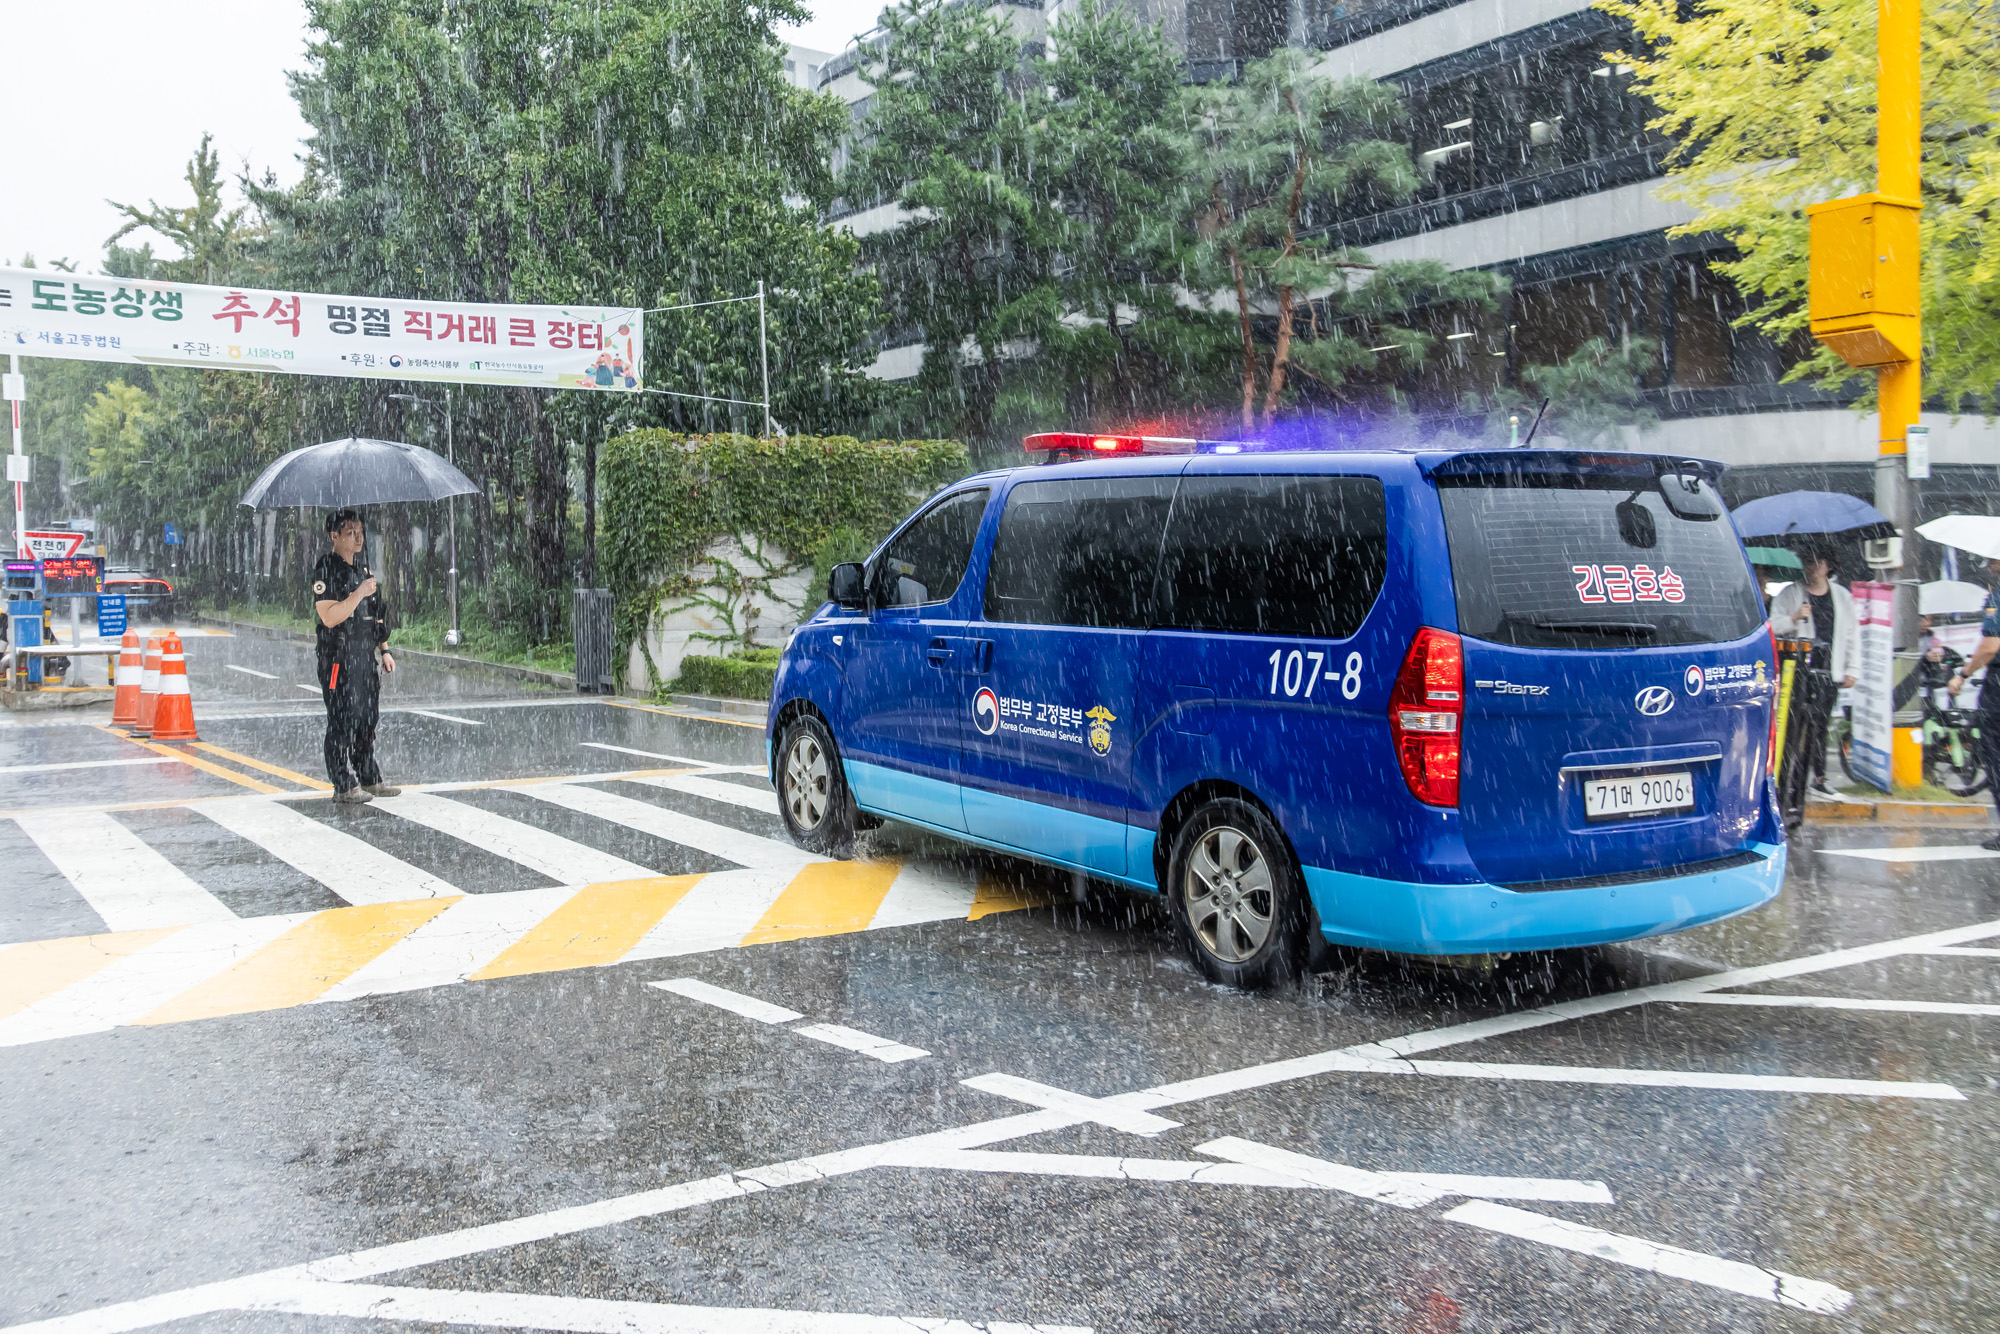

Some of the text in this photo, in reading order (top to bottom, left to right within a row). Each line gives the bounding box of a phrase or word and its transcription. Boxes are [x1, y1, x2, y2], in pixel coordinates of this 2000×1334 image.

[31, 279, 184, 322] 도농상생
[212, 291, 302, 338] 추석
[327, 304, 391, 338] 명절
[404, 310, 497, 345] 직거래
[507, 317, 536, 347] 큰
[547, 321, 604, 351] 장터
[37, 331, 121, 349] 서울고등법원
[247, 347, 294, 360] 서울농협
[407, 358, 459, 369] 농림축산식품부
[1572, 564, 1686, 603] 긴급호송
[1269, 649, 1363, 700] 107-8
[1704, 666, 1726, 682] 법무부
[1494, 680, 1550, 696] Starex
[1000, 696, 1083, 729] 법무부 교정본부
[1000, 720, 1083, 744] Korea Correctional Service
[1597, 779, 1684, 809] 71머 9006
